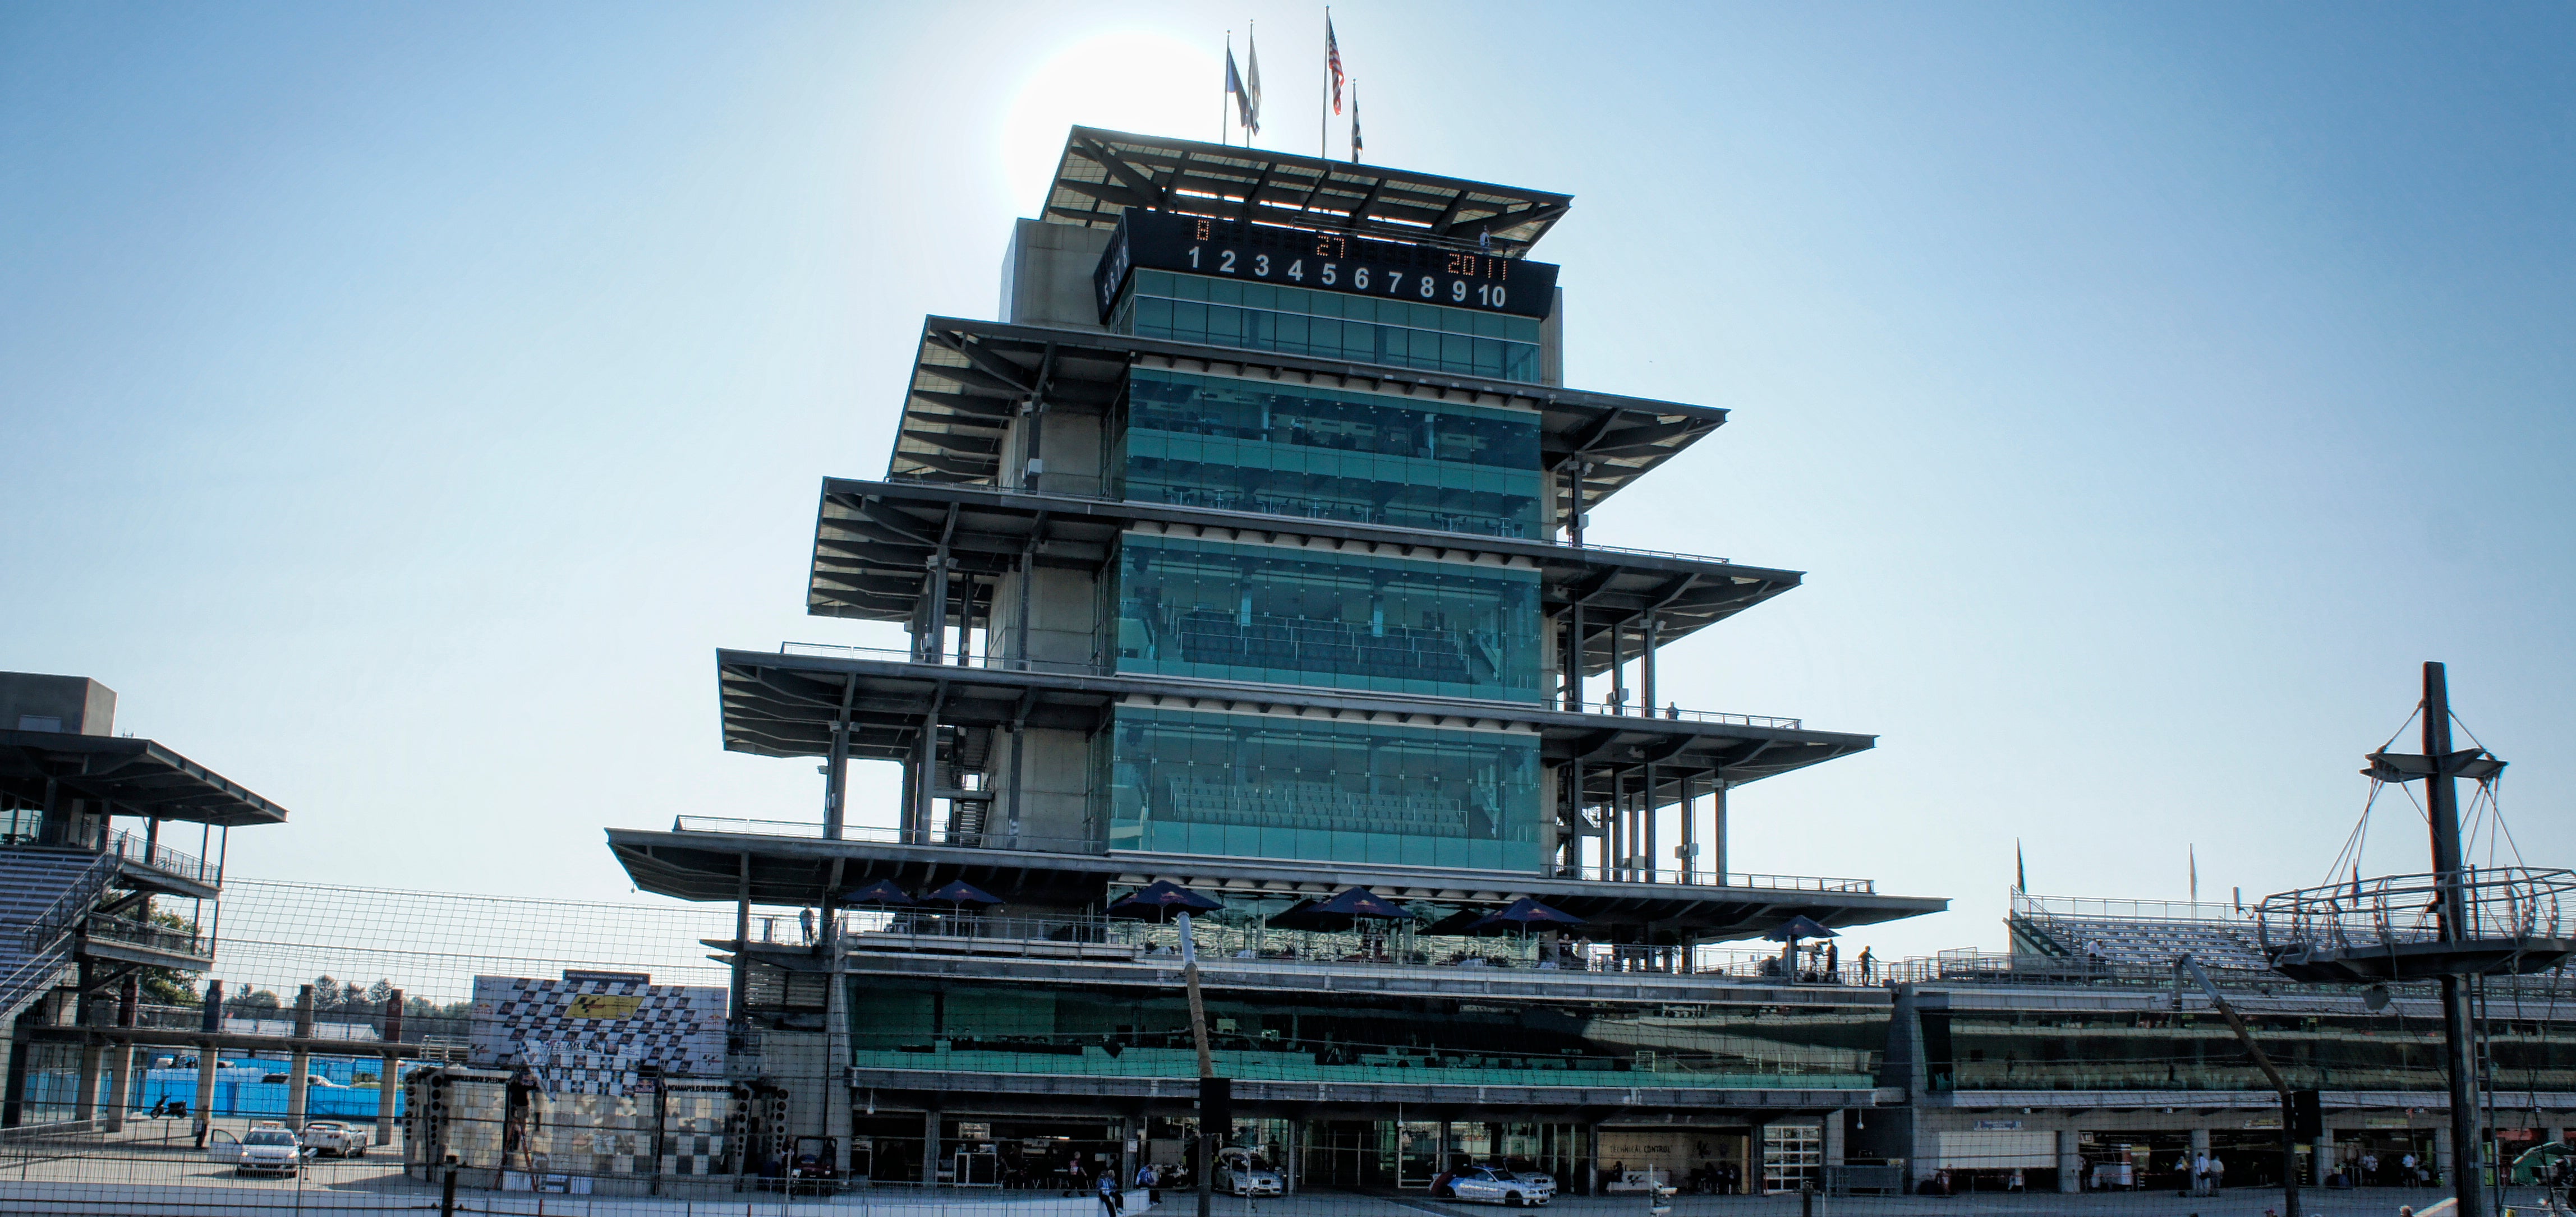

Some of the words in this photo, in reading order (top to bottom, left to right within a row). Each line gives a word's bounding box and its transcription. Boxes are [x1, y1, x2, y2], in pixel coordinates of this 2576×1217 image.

[1189, 246, 1200, 269] 1
[1219, 250, 1236, 273] 2
[1254, 254, 1269, 276] 3
[1287, 259, 1303, 281] 4
[1322, 262, 1336, 285] 5
[1354, 267, 1369, 289] 6
[1388, 271, 1402, 293] 7
[1420, 276, 1434, 298] 8
[1452, 280, 1466, 302] 9
[1478, 284, 1506, 307] 10
[1317, 235, 1345, 259] 27
[1447, 253, 1507, 280] 2011
[1610, 1145, 1641, 1153] TECHNICAL
[1644, 1145, 1671, 1154] CONTROL
